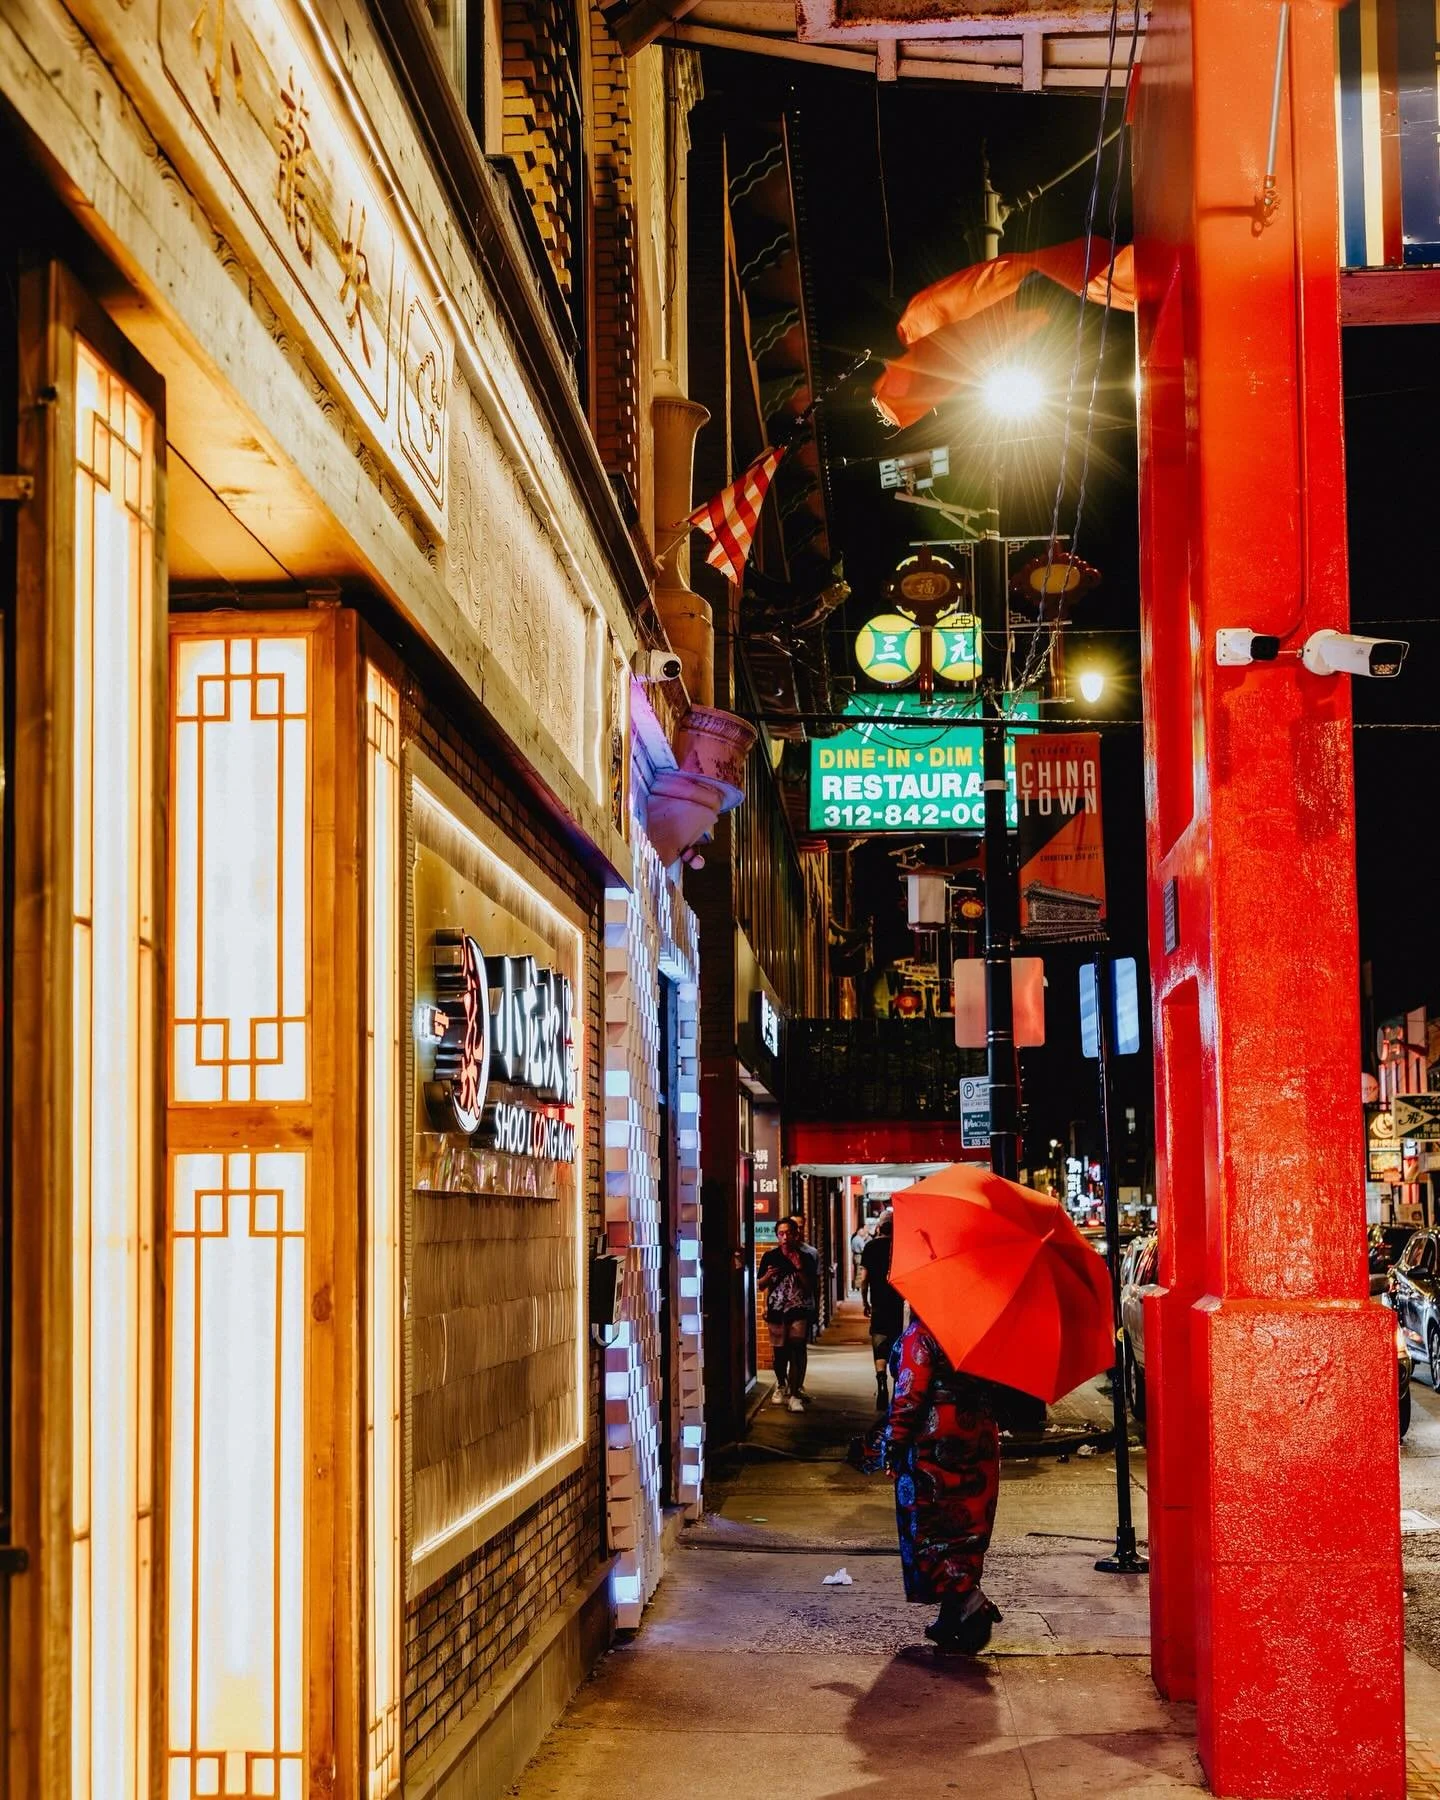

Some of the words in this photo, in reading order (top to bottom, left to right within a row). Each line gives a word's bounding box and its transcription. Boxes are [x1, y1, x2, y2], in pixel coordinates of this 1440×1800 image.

[819, 748, 911, 769] DINE-IN
[929, 746, 973, 767] DIM
[821, 772, 1018, 801] RESTAURA
[1021, 760, 1096, 789] CHINA
[824, 803, 1018, 827] 312-842-00
[1021, 787, 1097, 816] TOWN
[495, 1101, 526, 1154] SHOO
[558, 1121, 576, 1163] KAN
[760, 1178, 777, 1193] Eat
